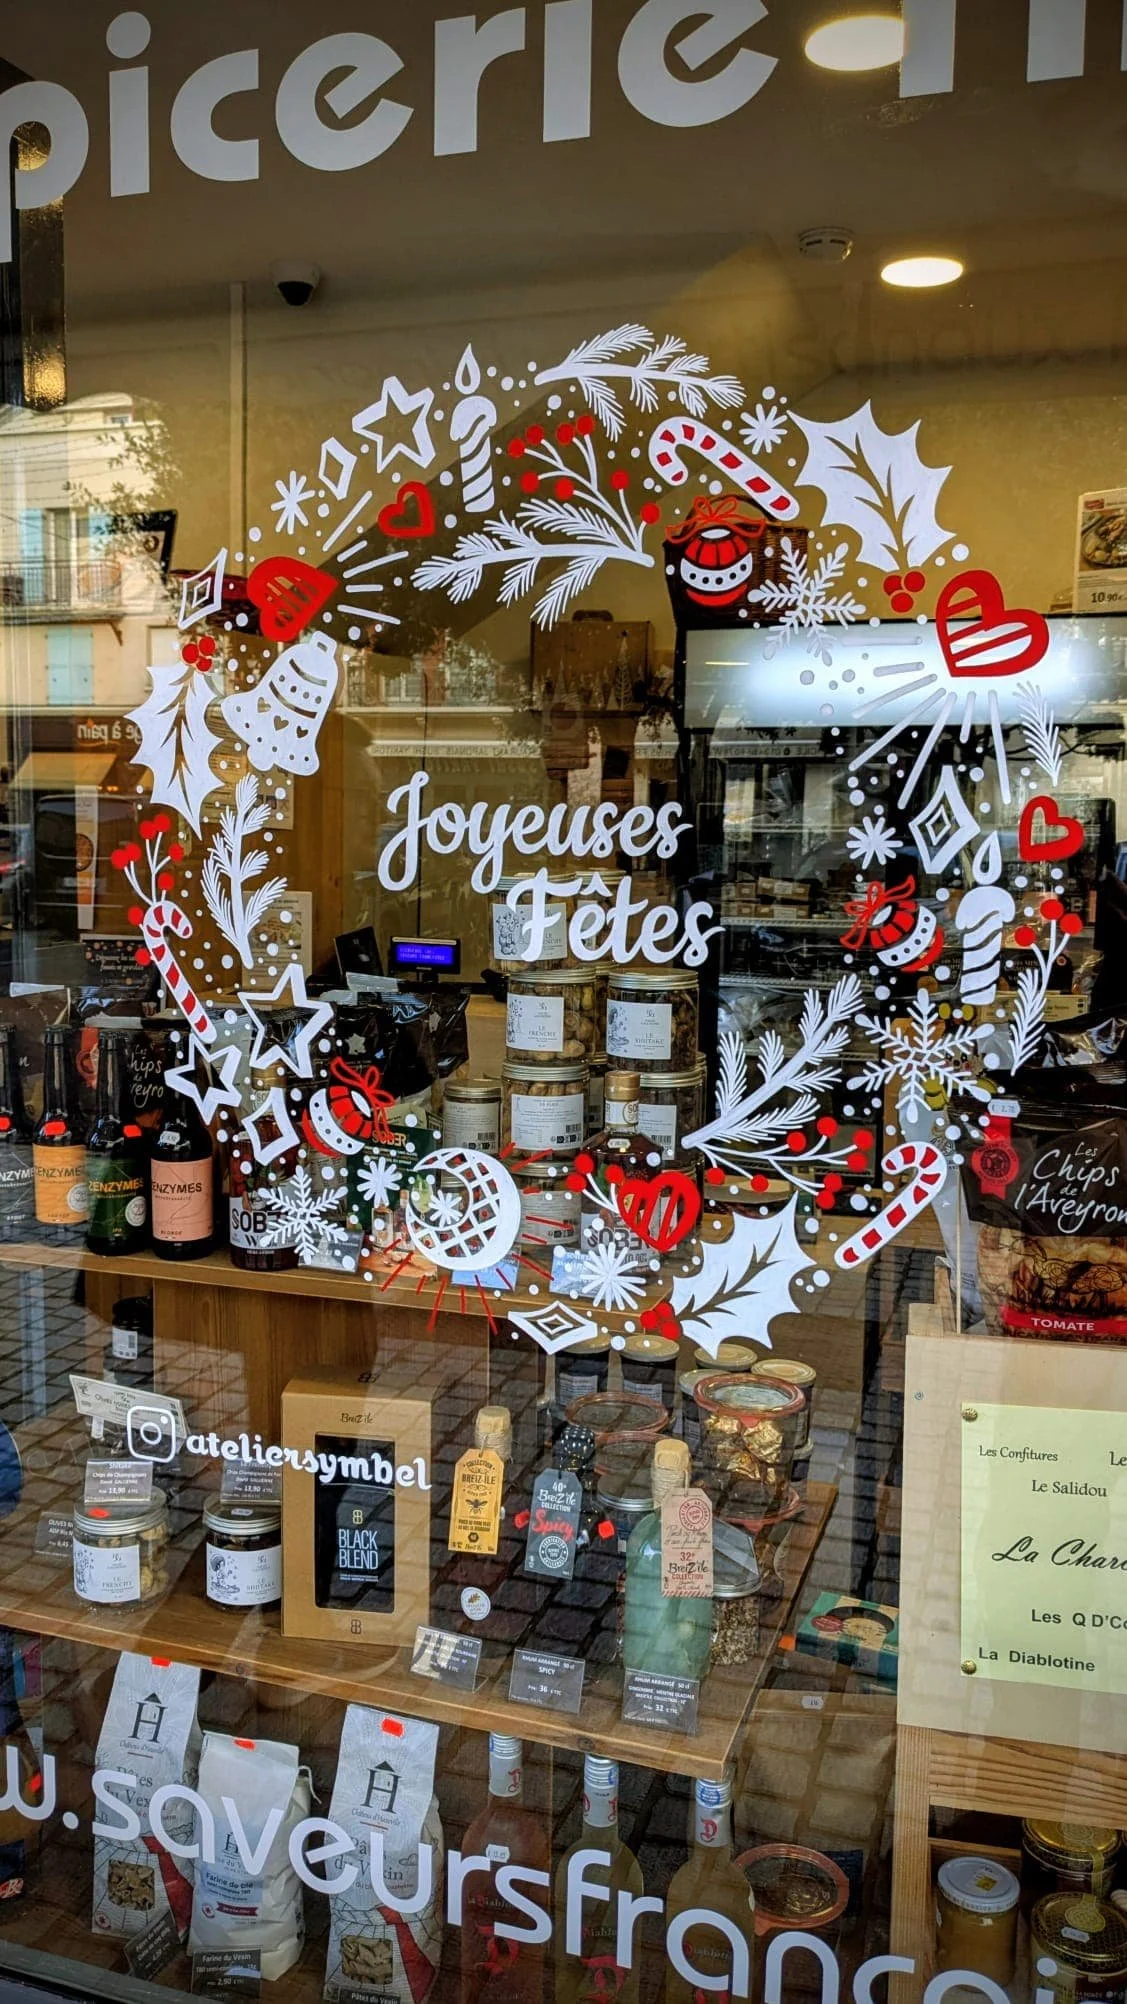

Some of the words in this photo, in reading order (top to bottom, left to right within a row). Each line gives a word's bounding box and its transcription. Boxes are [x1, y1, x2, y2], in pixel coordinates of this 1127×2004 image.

[377, 770, 693, 894] Joyeuses
[506, 867, 726, 967] Fêtes
[129, 1052, 163, 1079] hips
[1074, 1142, 1098, 1157] Les
[1033, 1149, 1119, 1192] Chips
[1060, 1183, 1078, 1196] de
[1031, 1317, 1095, 1331] TOMATE
[186, 1433, 432, 1491] ateliersymbel
[979, 1445, 998, 1457] Les
[1000, 1446, 1059, 1463] Confitures
[1032, 1479, 1048, 1492] Le
[1052, 1481, 1108, 1498] Salidou
[541, 1501, 571, 1512] COLLECTION
[531, 1508, 575, 1543] Spicy
[339, 1529, 379, 1550] BLACK
[991, 1536, 1040, 1563] La
[339, 1549, 379, 1570] BLEND
[671, 1573, 704, 1581] COLLECTION
[1031, 1609, 1062, 1624] Les
[1072, 1612, 1086, 1628] Q
[978, 1646, 999, 1660] La
[1009, 1650, 1096, 1672] Diablotine
[538, 1666, 556, 1675] SPICY
[655, 1703, 665, 1712] 32
[202, 1954, 222, 1962] Farine
